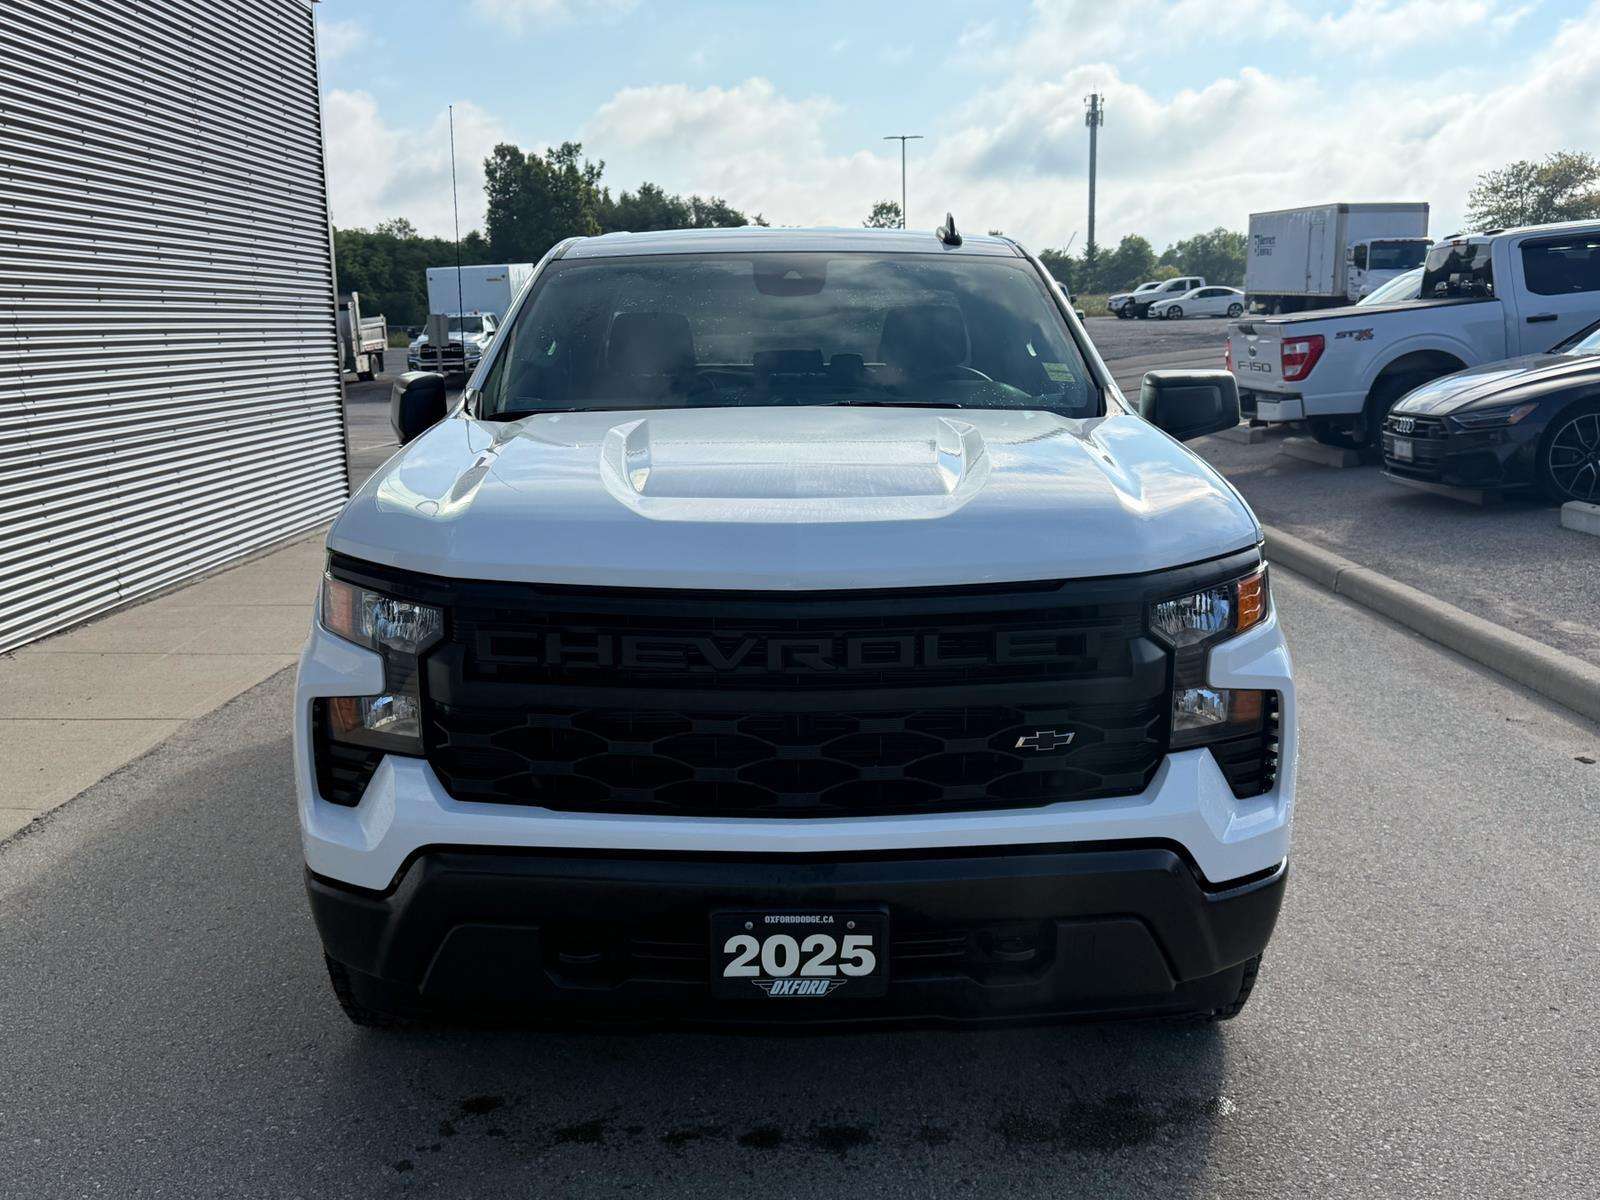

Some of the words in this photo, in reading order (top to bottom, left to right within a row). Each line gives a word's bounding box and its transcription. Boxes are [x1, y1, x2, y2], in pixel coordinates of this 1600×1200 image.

[1335, 328, 1375, 341] STX
[1238, 360, 1272, 373] F-150
[764, 915, 834, 924] OXFORDDODGE.CA
[723, 934, 876, 977] 2025
[770, 980, 830, 995] OXFORD
